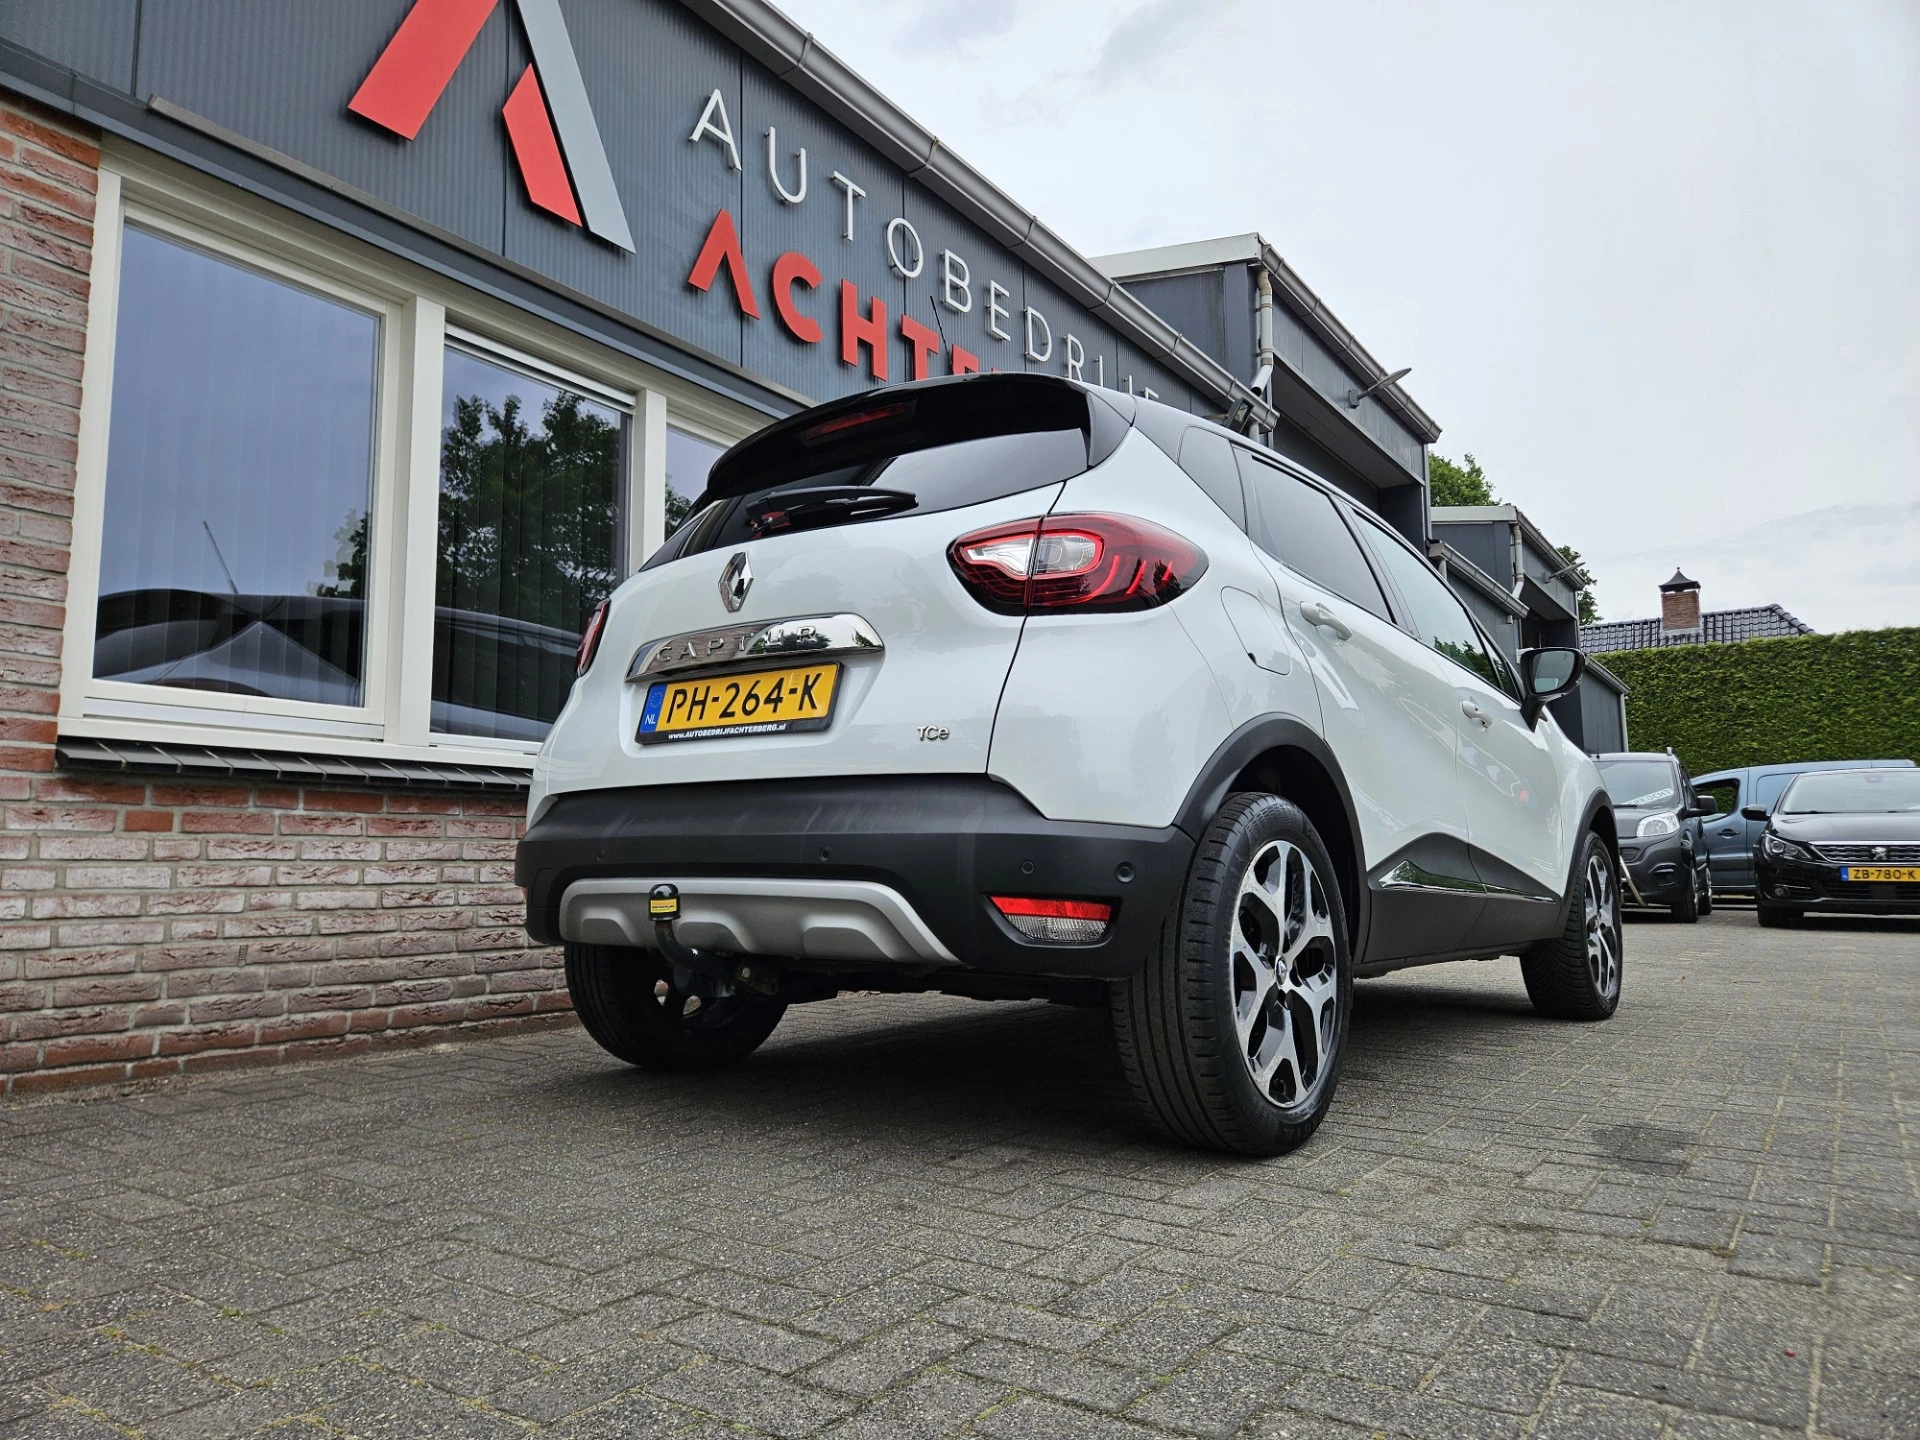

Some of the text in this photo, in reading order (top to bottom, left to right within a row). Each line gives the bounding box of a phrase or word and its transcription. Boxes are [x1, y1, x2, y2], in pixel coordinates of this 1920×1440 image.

[689, 88, 1159, 400] AUTOBEDRI
[688, 208, 1000, 382] ACHT
[656, 625, 818, 662] CAPTUR
[666, 672, 823, 724] PH-264-K
[644, 714, 656, 725] NL
[668, 723, 787, 740] www.AUTOBEDRIJFACHTERBERG.nl
[917, 725, 950, 742] TCe
[1631, 789, 1671, 805] RKOCHT
[1853, 869, 1916, 880] ZB-780-K
